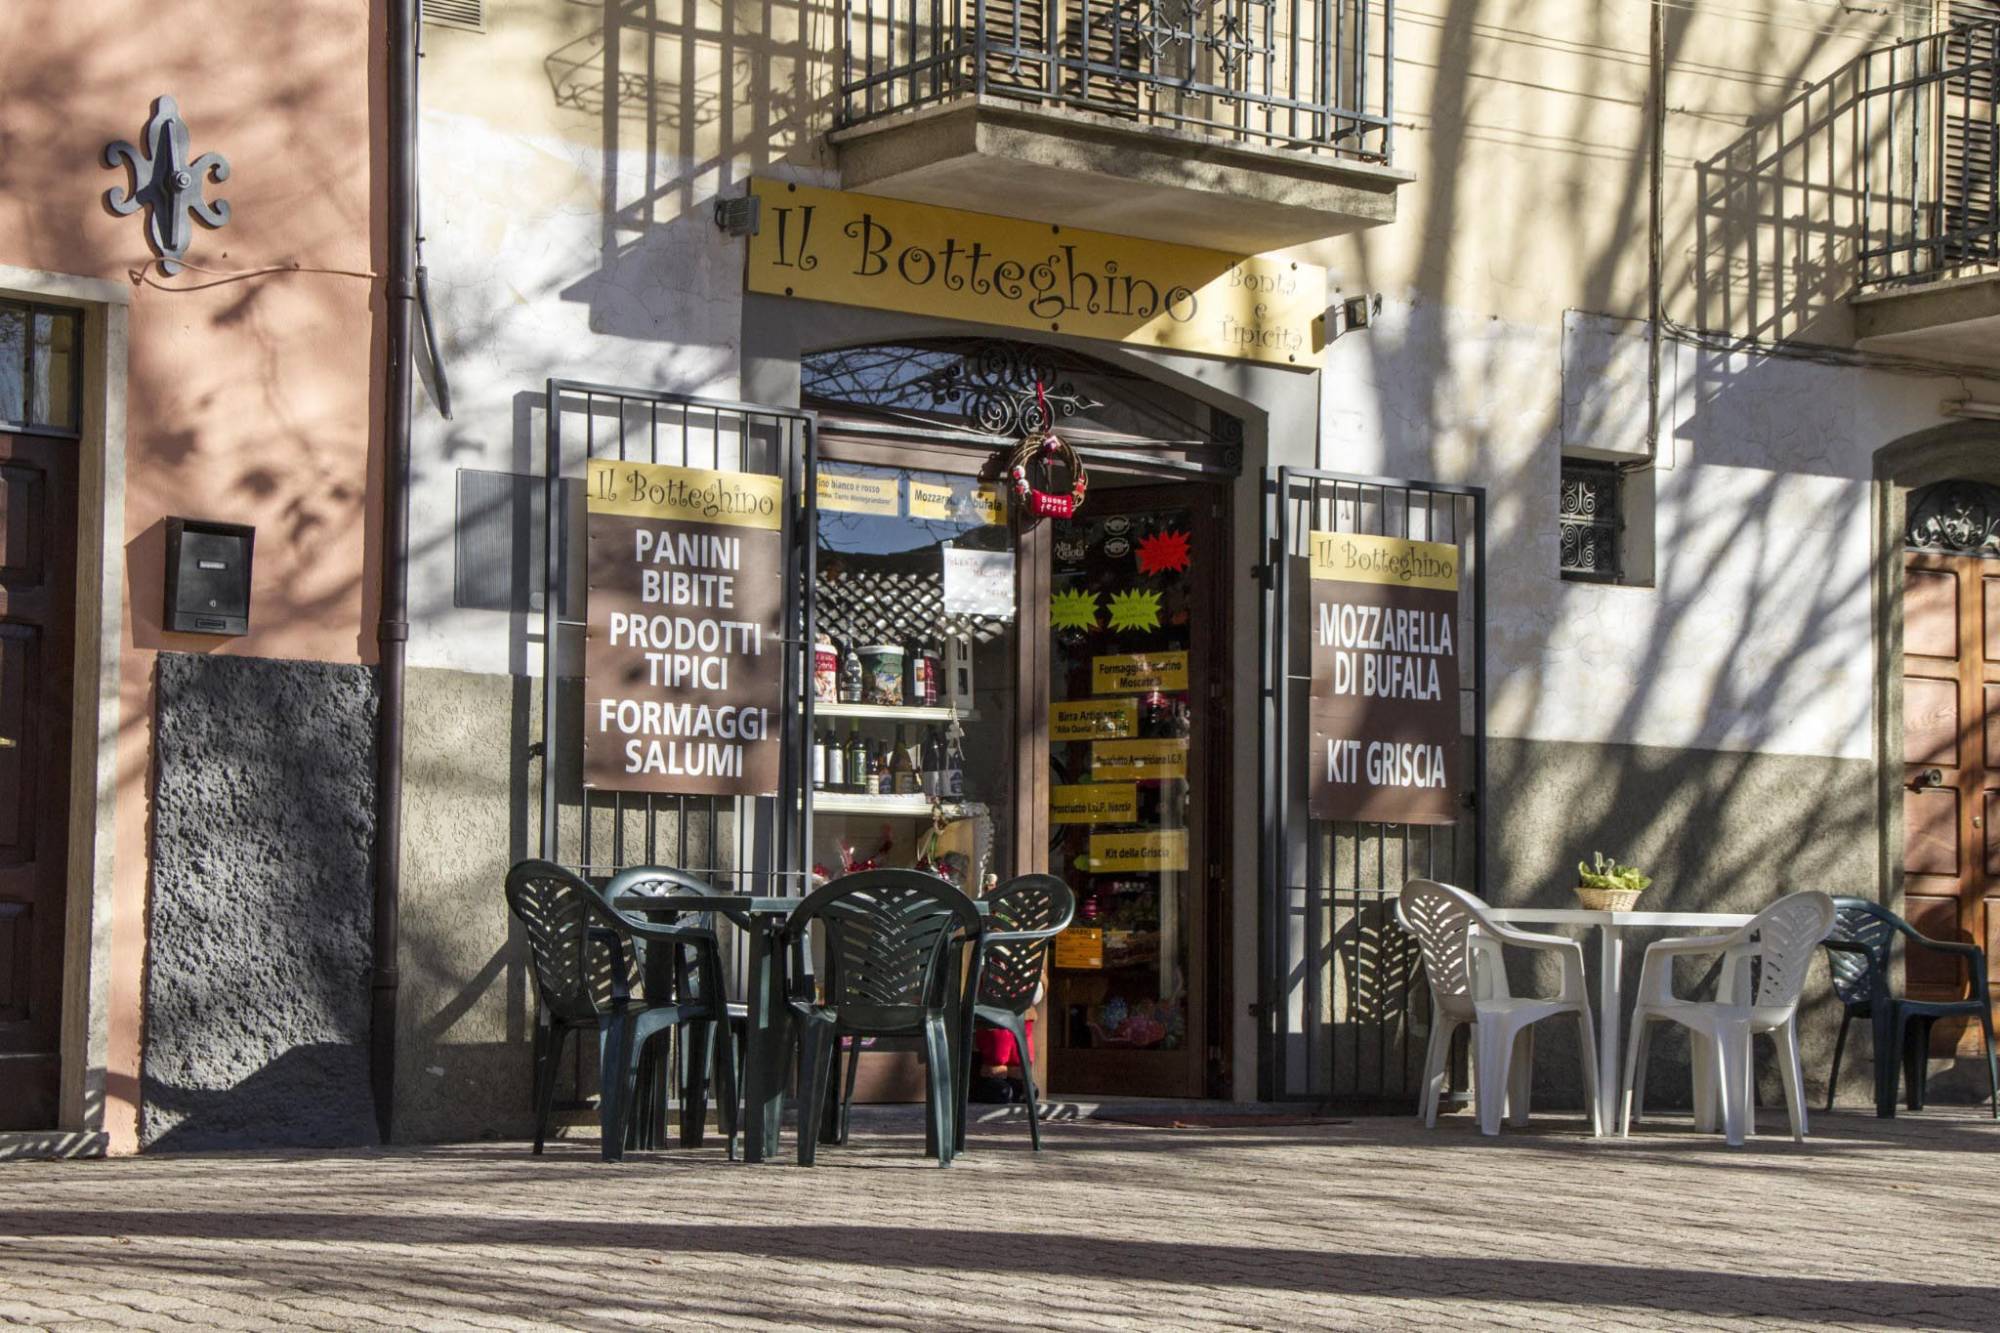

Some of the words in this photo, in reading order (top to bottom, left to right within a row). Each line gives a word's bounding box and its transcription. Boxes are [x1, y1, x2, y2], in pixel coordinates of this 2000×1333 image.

[772, 206, 817, 271] Il
[844, 213, 1198, 323] Botteghino
[1254, 303, 1268, 319] e
[597, 468, 617, 501] Il
[626, 470, 774, 517] Botteghino
[635, 528, 740, 571] PANINI
[1317, 539, 1334, 569] Il
[1341, 540, 1453, 581] Botteghino
[641, 569, 735, 609] BIBITE
[609, 612, 762, 656] PRODOTTI
[1319, 602, 1454, 656] MOZZARELLA
[644, 652, 729, 691] TIPICI
[1334, 651, 1357, 696] DI
[1363, 652, 1442, 701] BUFALA
[599, 698, 768, 741] FORMAGGI
[625, 739, 743, 778] SALUMI
[1327, 739, 1361, 784] KIT
[1366, 740, 1447, 788] GRISCIA
[1104, 848, 1118, 859] Kit
